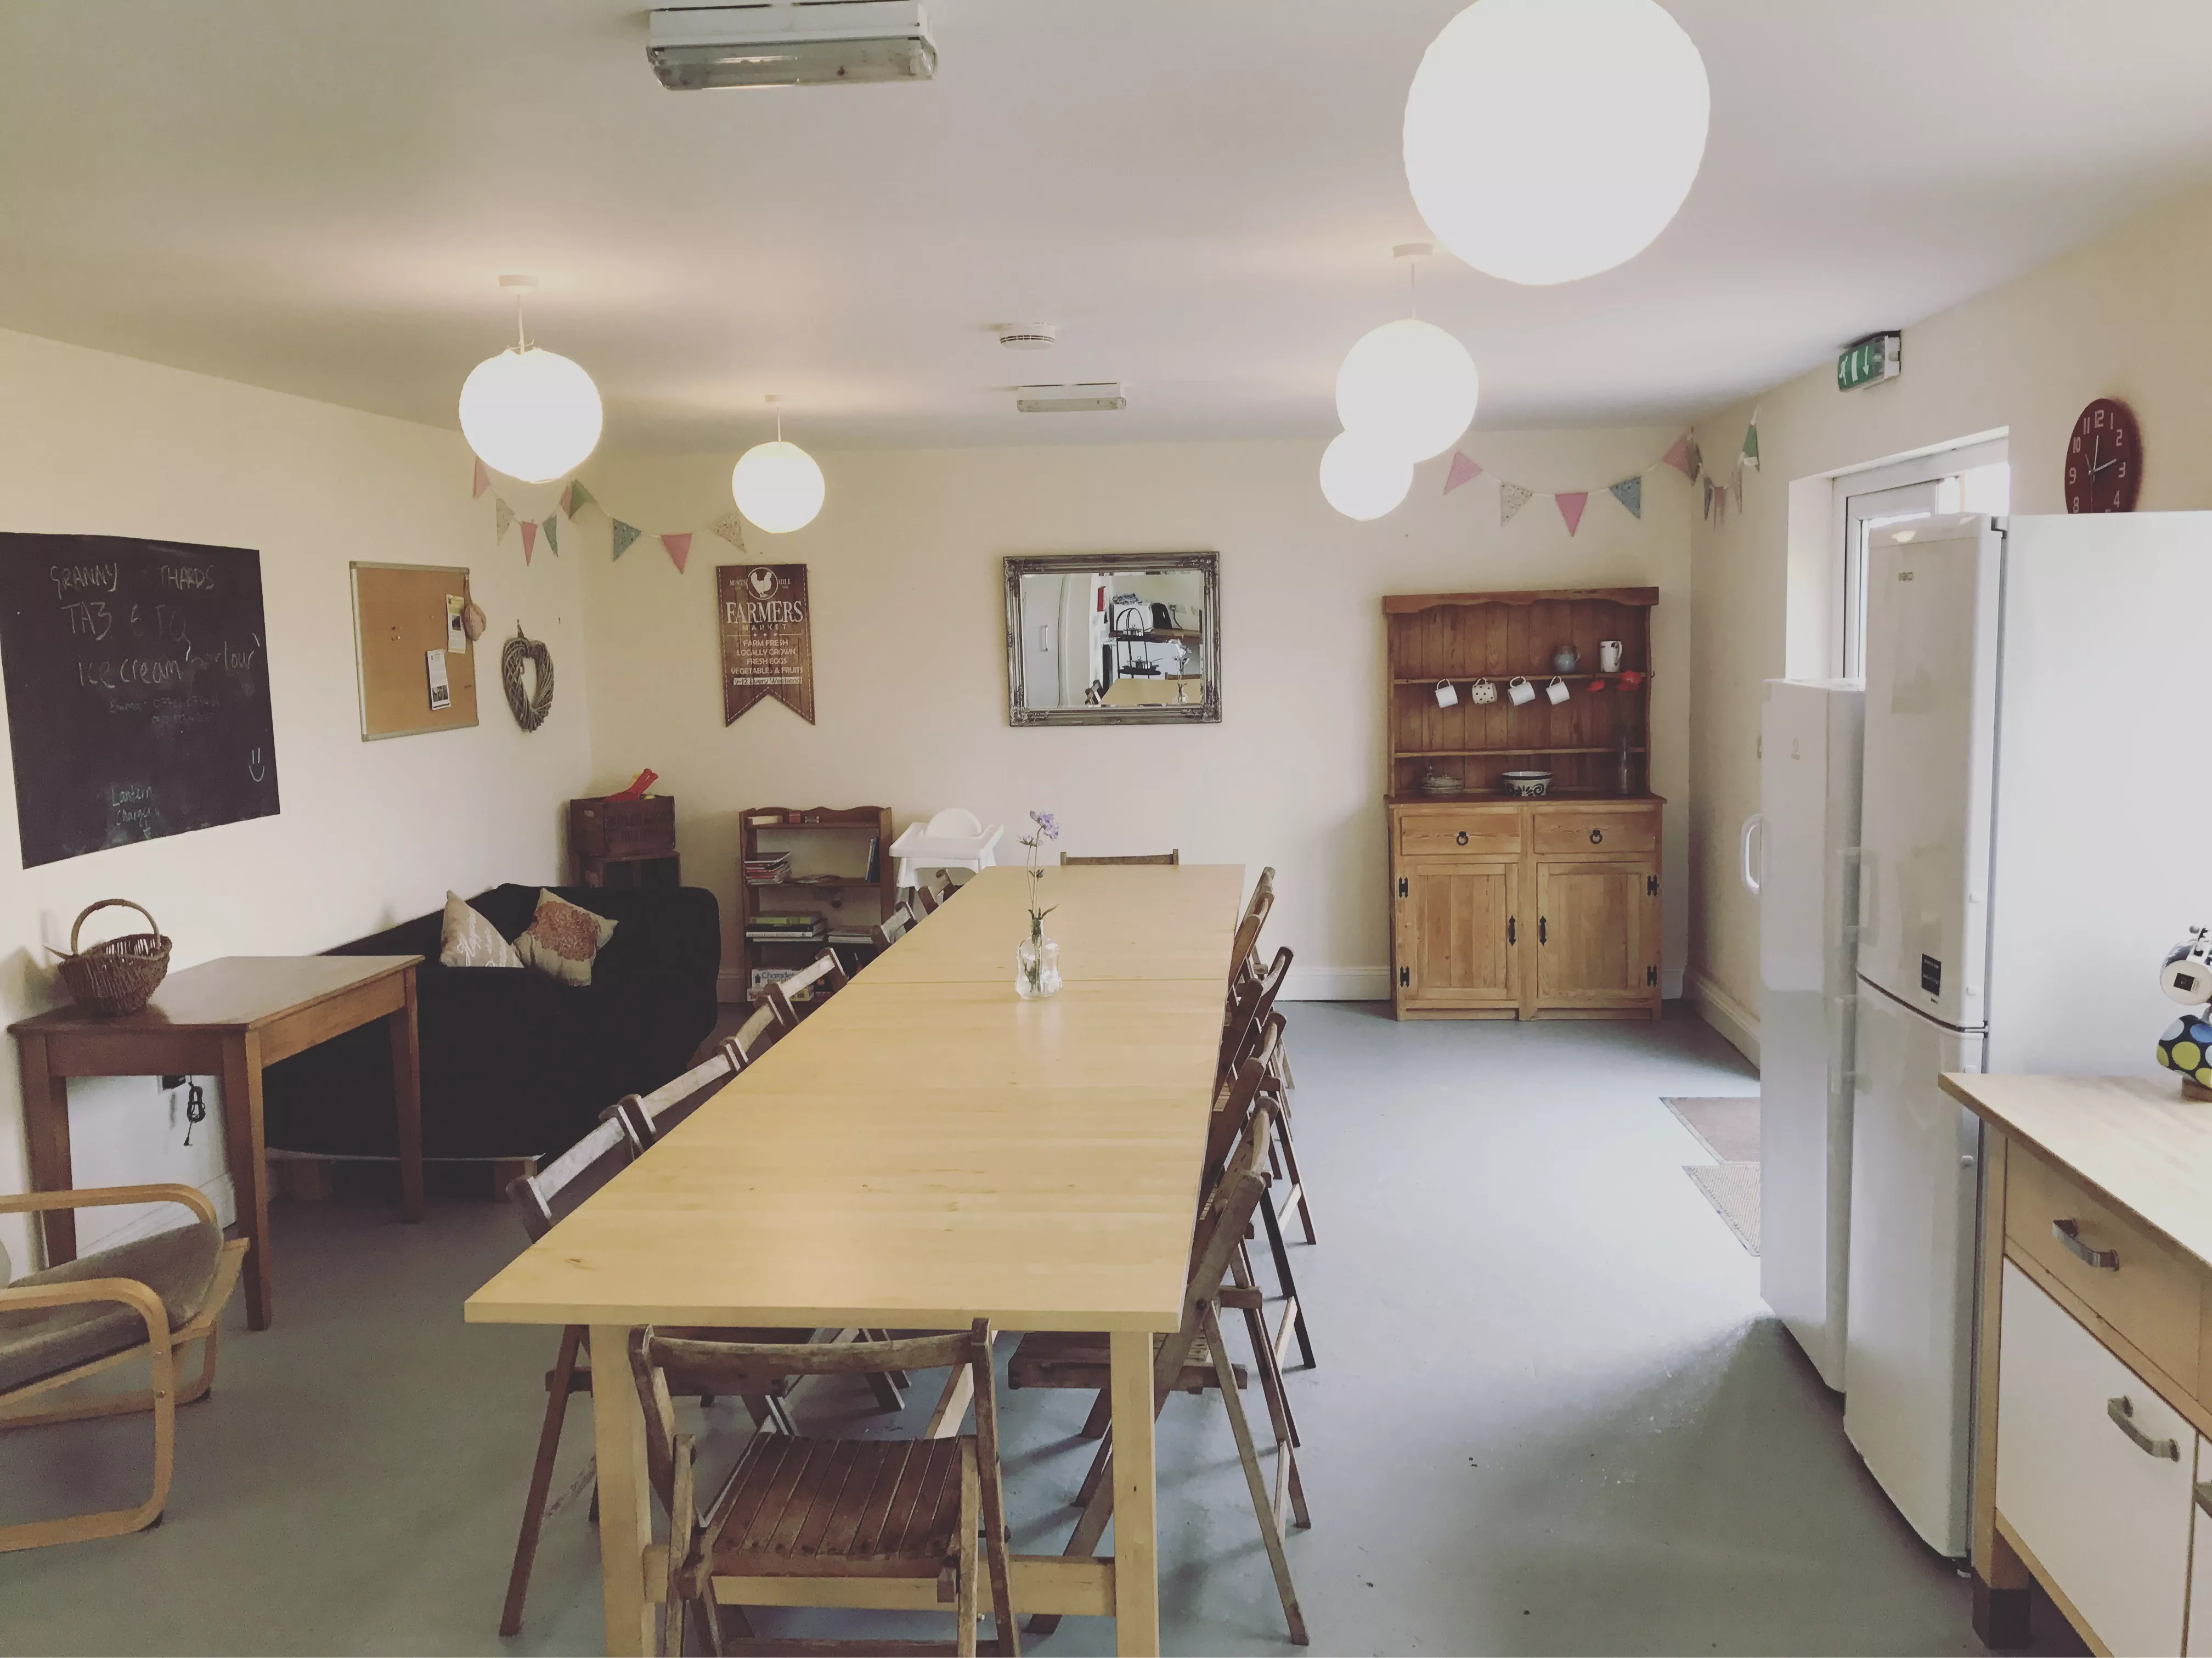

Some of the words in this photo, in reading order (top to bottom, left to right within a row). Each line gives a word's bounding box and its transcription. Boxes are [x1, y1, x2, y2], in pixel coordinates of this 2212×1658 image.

[2083, 416, 2090, 435] 11
[2094, 409, 2104, 428] 12
[2110, 413, 2114, 430] 1
[2073, 436, 2081, 454] 10
[2115, 429, 2123, 447] 2
[2069, 467, 2076, 484] 9
[2118, 461, 2126, 478] 3
[2073, 496, 2079, 514] 8
[2113, 490, 2120, 508] 4
[50, 563, 119, 599] GRANNY
[725, 601, 804, 624] FARMERS
